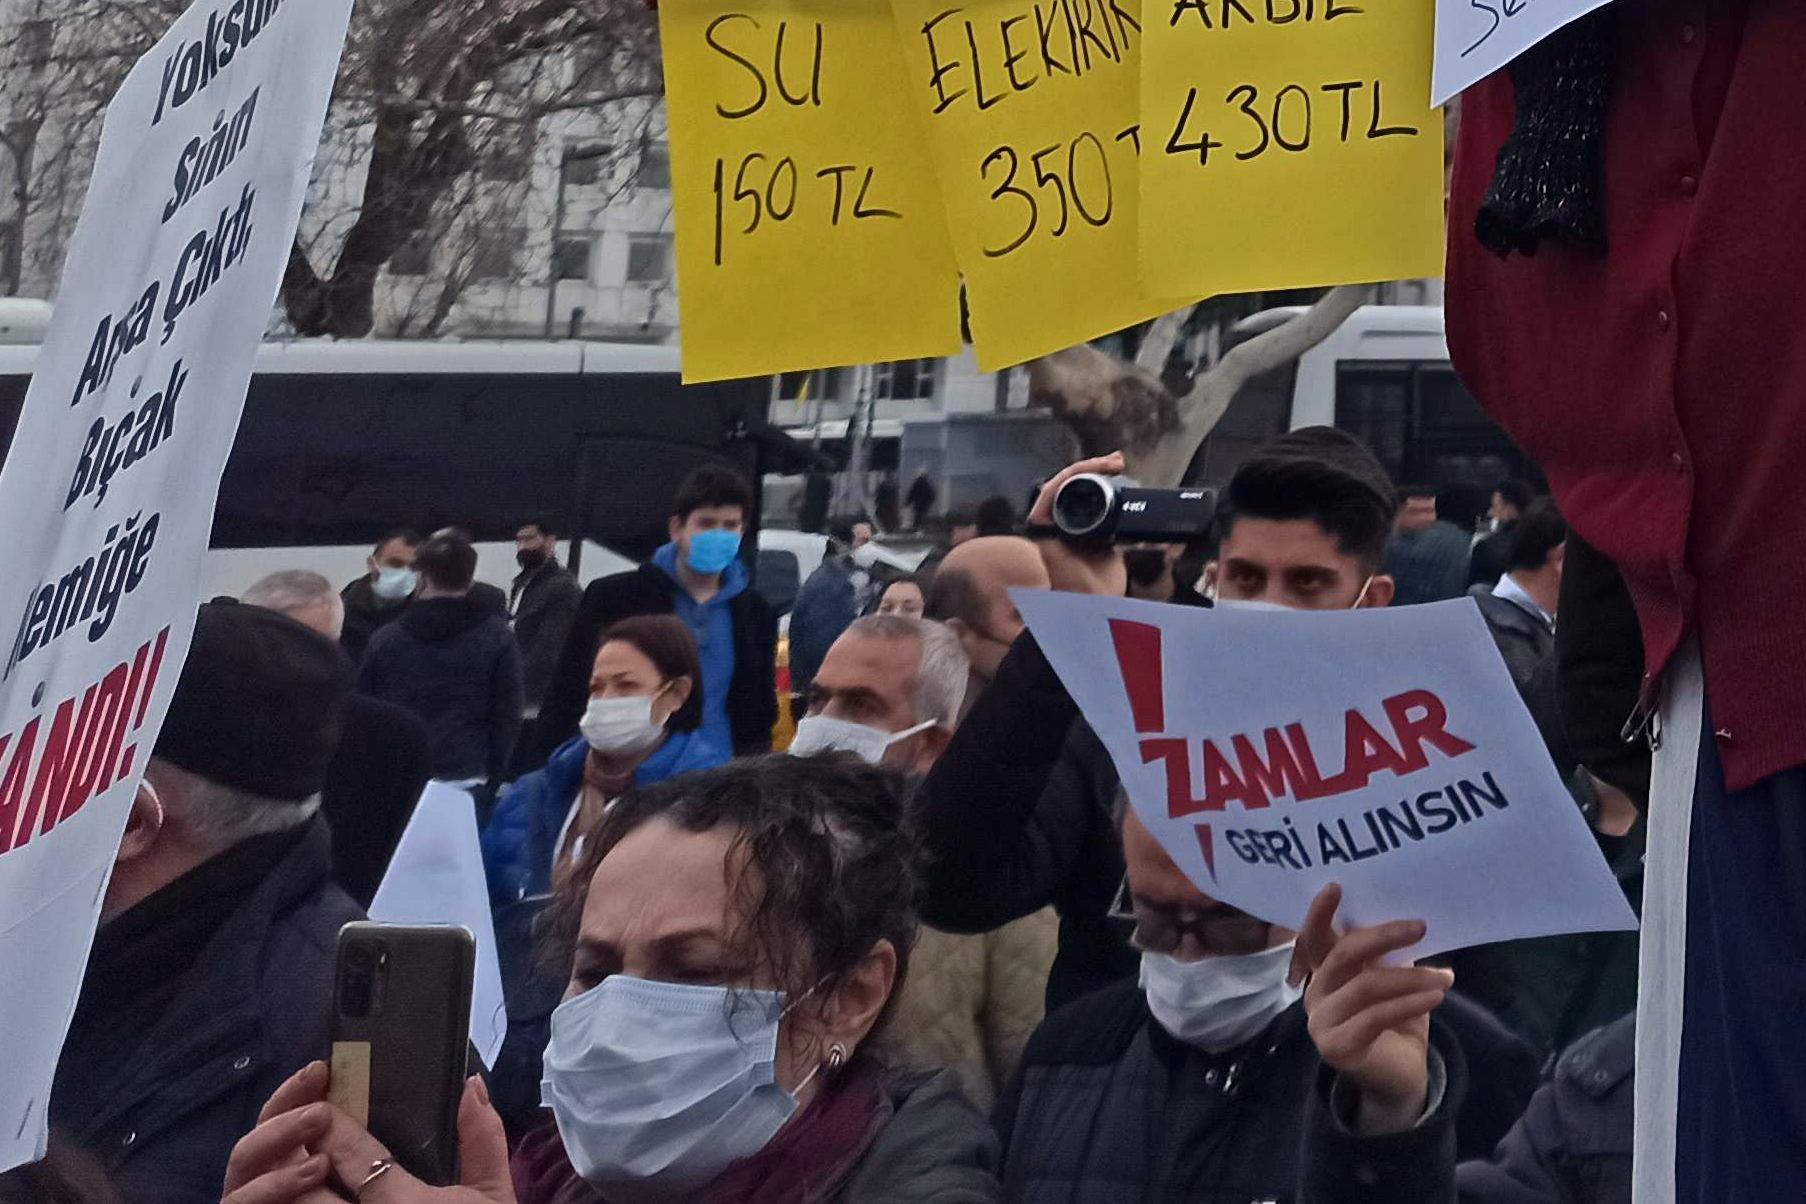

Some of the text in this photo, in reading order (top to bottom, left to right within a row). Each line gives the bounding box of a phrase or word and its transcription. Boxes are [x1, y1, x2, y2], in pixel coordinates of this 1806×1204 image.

[705, 13, 822, 120] SU
[713, 152, 904, 267] 150 TL
[980, 131, 1113, 258] 350
[63, 357, 190, 513] Bıçak
[1138, 688, 1476, 820] ZAMLAR
[1225, 770, 1511, 870] GERİ ALINSIN
